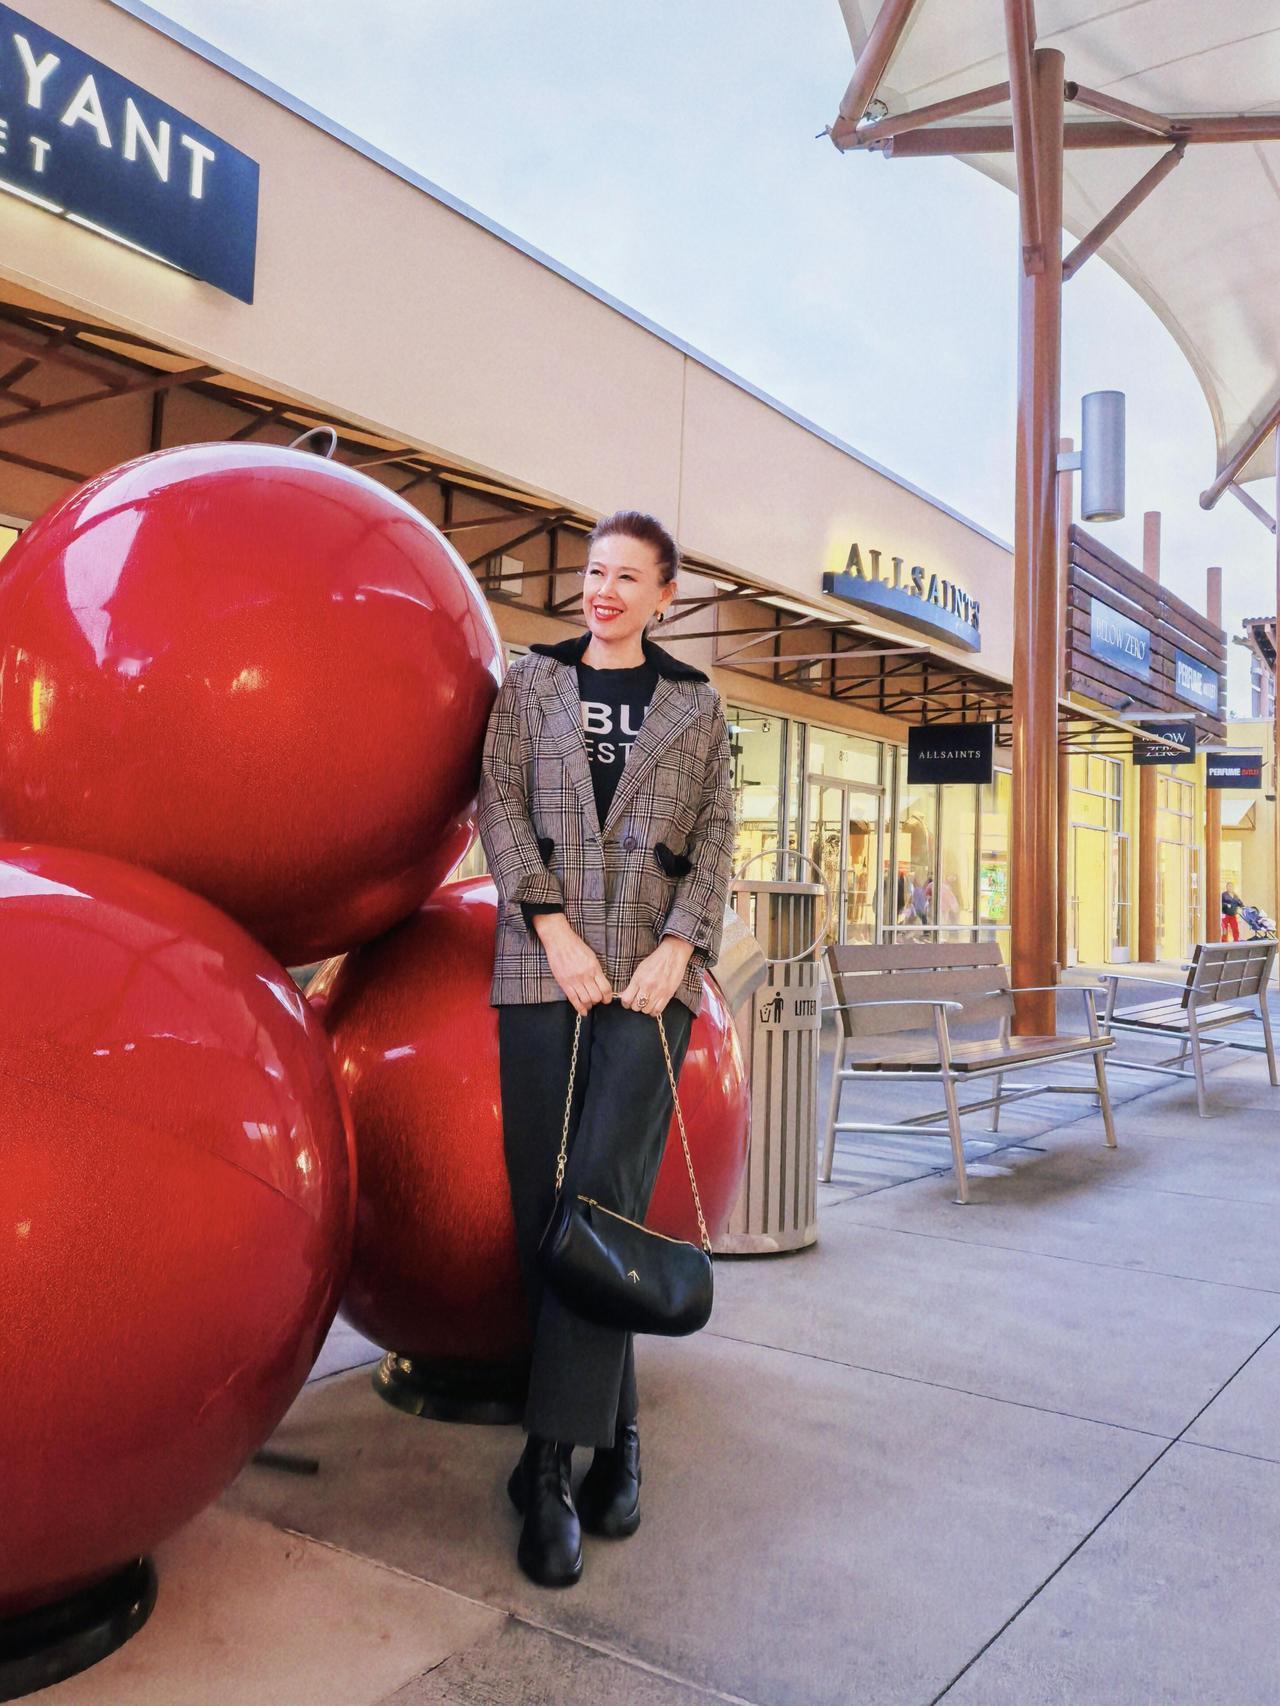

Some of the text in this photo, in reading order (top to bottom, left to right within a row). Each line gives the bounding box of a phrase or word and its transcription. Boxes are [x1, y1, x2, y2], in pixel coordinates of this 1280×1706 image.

[13, 34, 215, 199] YANT
[1124, 632, 1146, 660] ZERO
[918, 750, 981, 759] ALLSAINTS
[1208, 767, 1241, 776] PERFUME
[795, 1000, 816, 1016] LITTER
